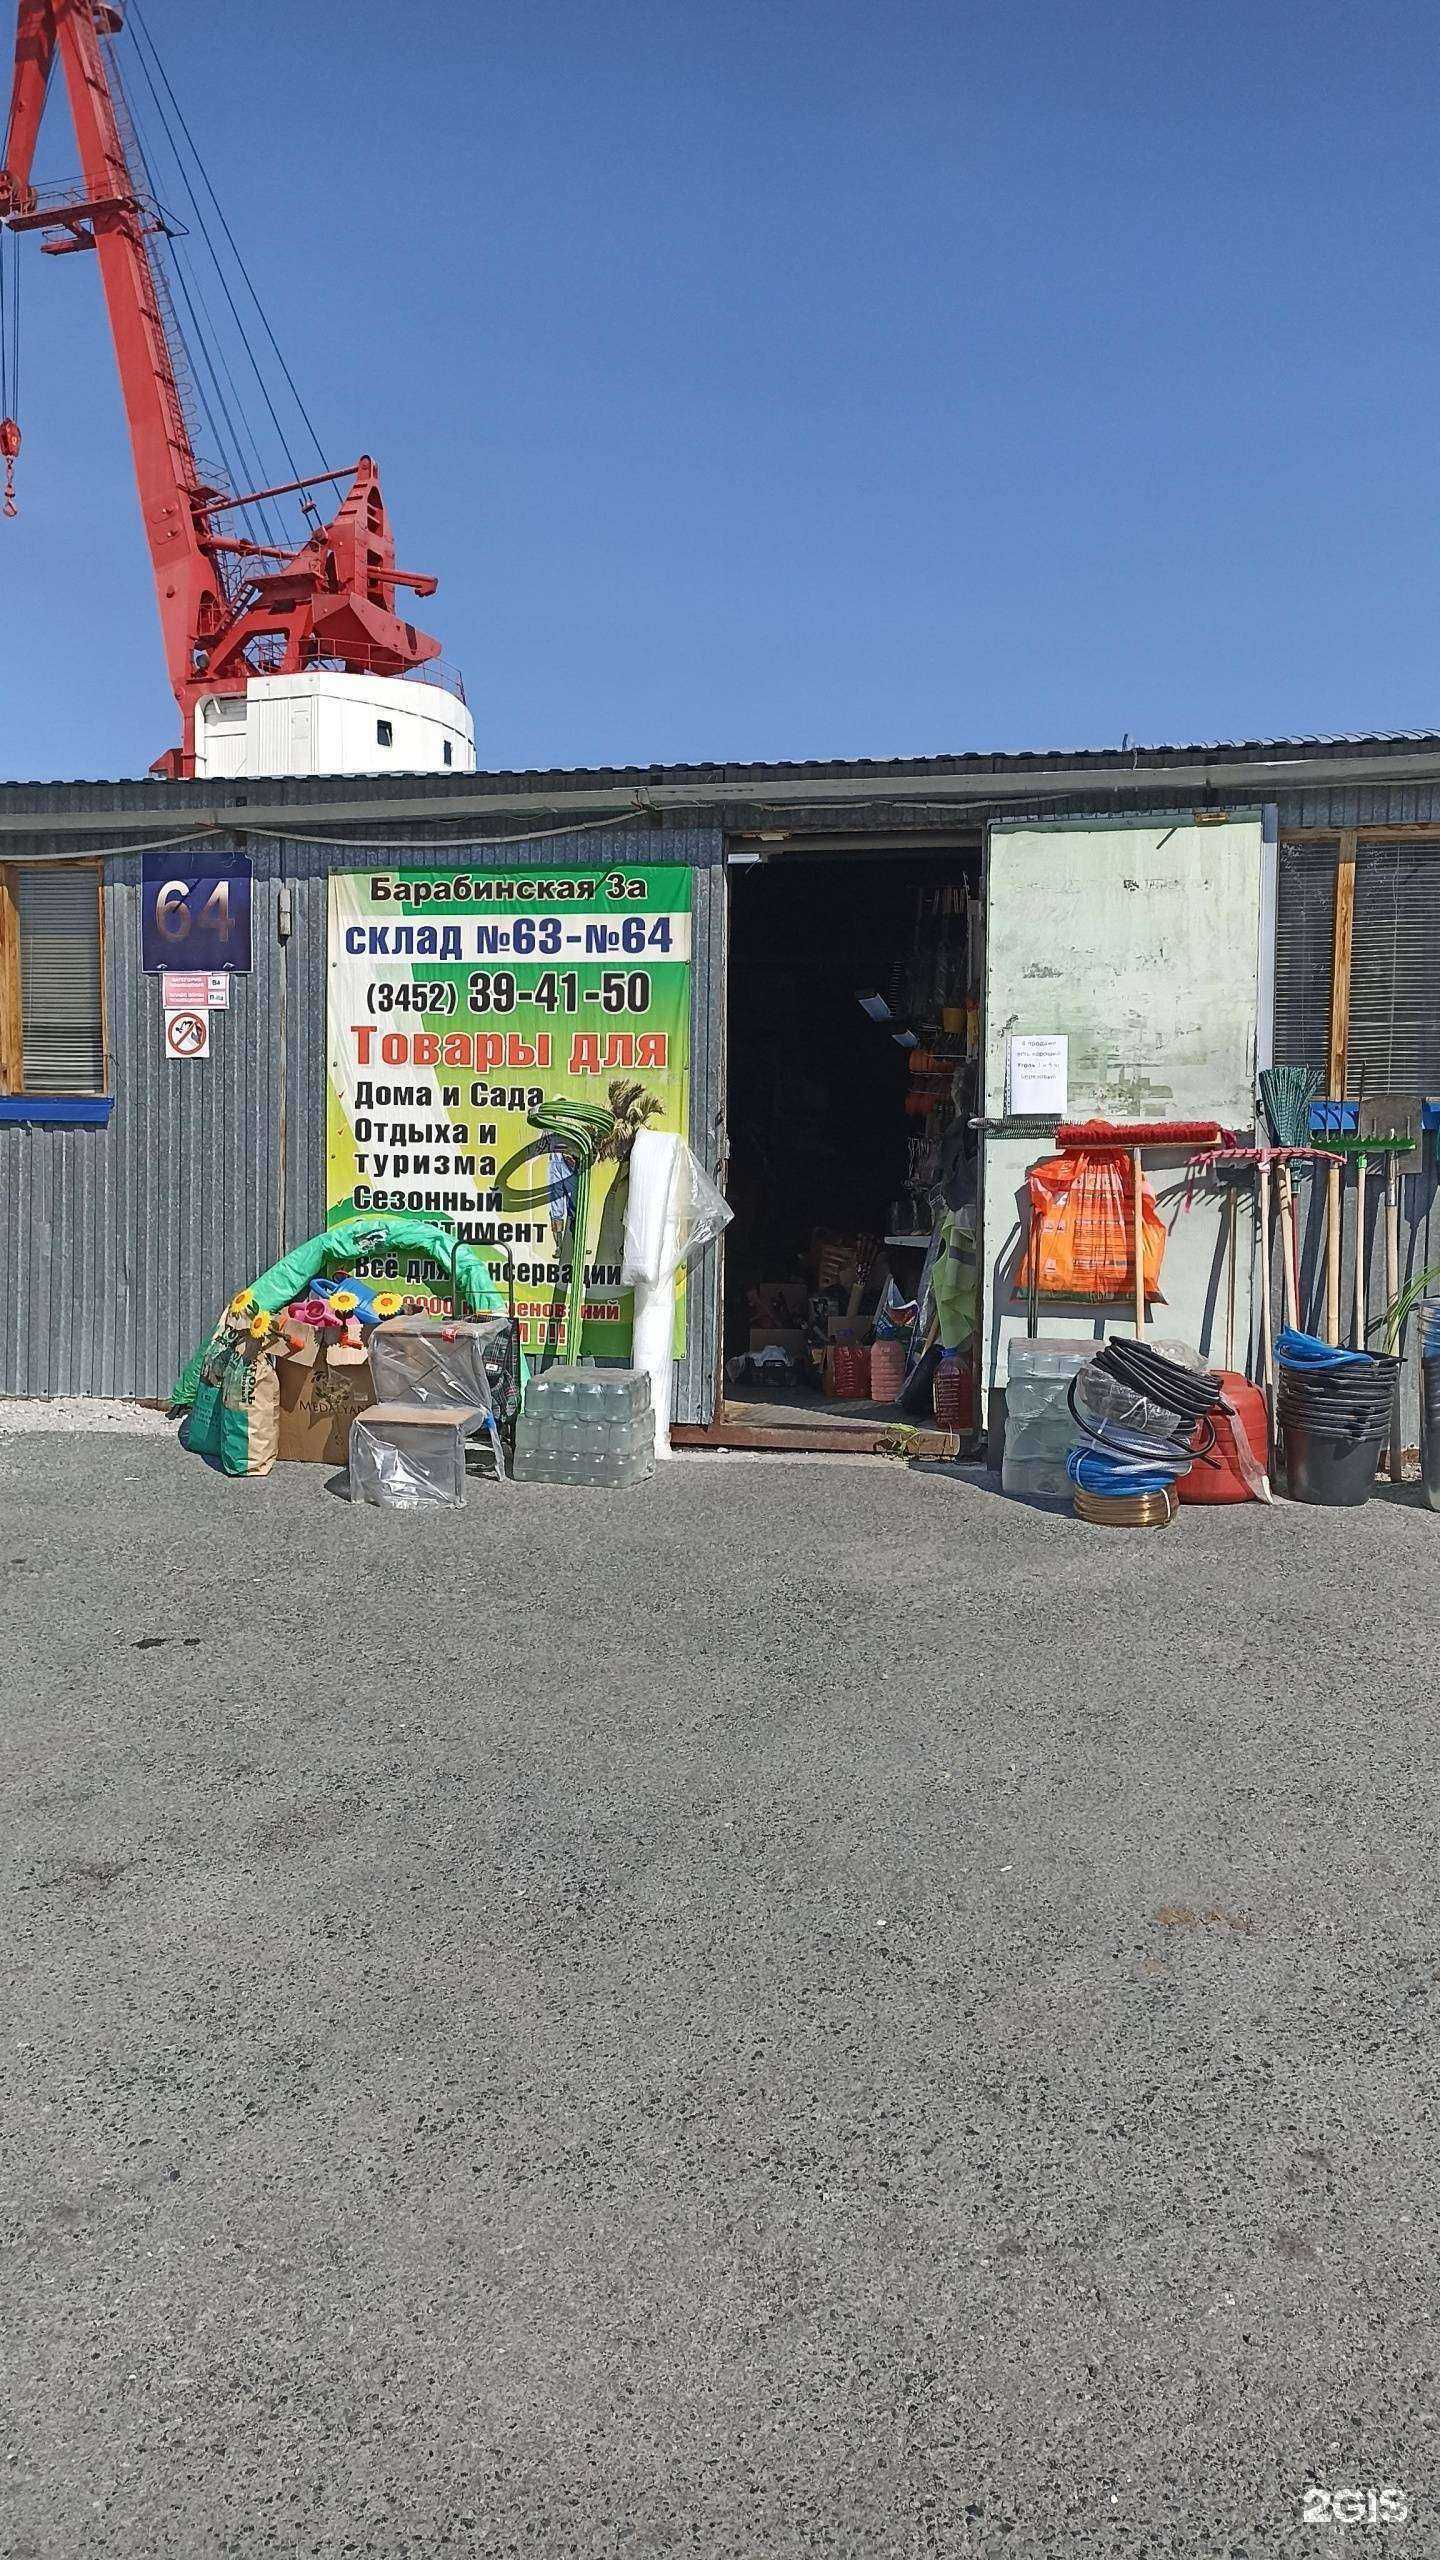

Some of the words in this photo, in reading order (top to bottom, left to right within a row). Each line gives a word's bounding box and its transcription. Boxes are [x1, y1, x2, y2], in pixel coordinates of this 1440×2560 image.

[371, 875, 595, 906] Барабинская
[156, 880, 235, 942] 64
[345, 926, 463, 960] склад
[477, 917, 673, 954] №63-№64
[367, 983, 457, 1014] (3452)
[469, 972, 650, 1013] 39-41-50
[351, 1026, 549, 1072] Товары
[569, 1034, 667, 1073] для
[354, 1081, 432, 1110] Дома
[442, 1086, 460, 1107] и
[470, 1082, 543, 1111] Сада
[355, 1118, 469, 1147] Отдыха
[479, 1124, 496, 1144] и
[354, 1153, 496, 1178] туризма
[353, 1185, 503, 1212] Сезонный
[356, 1253, 398, 1278] Всё
